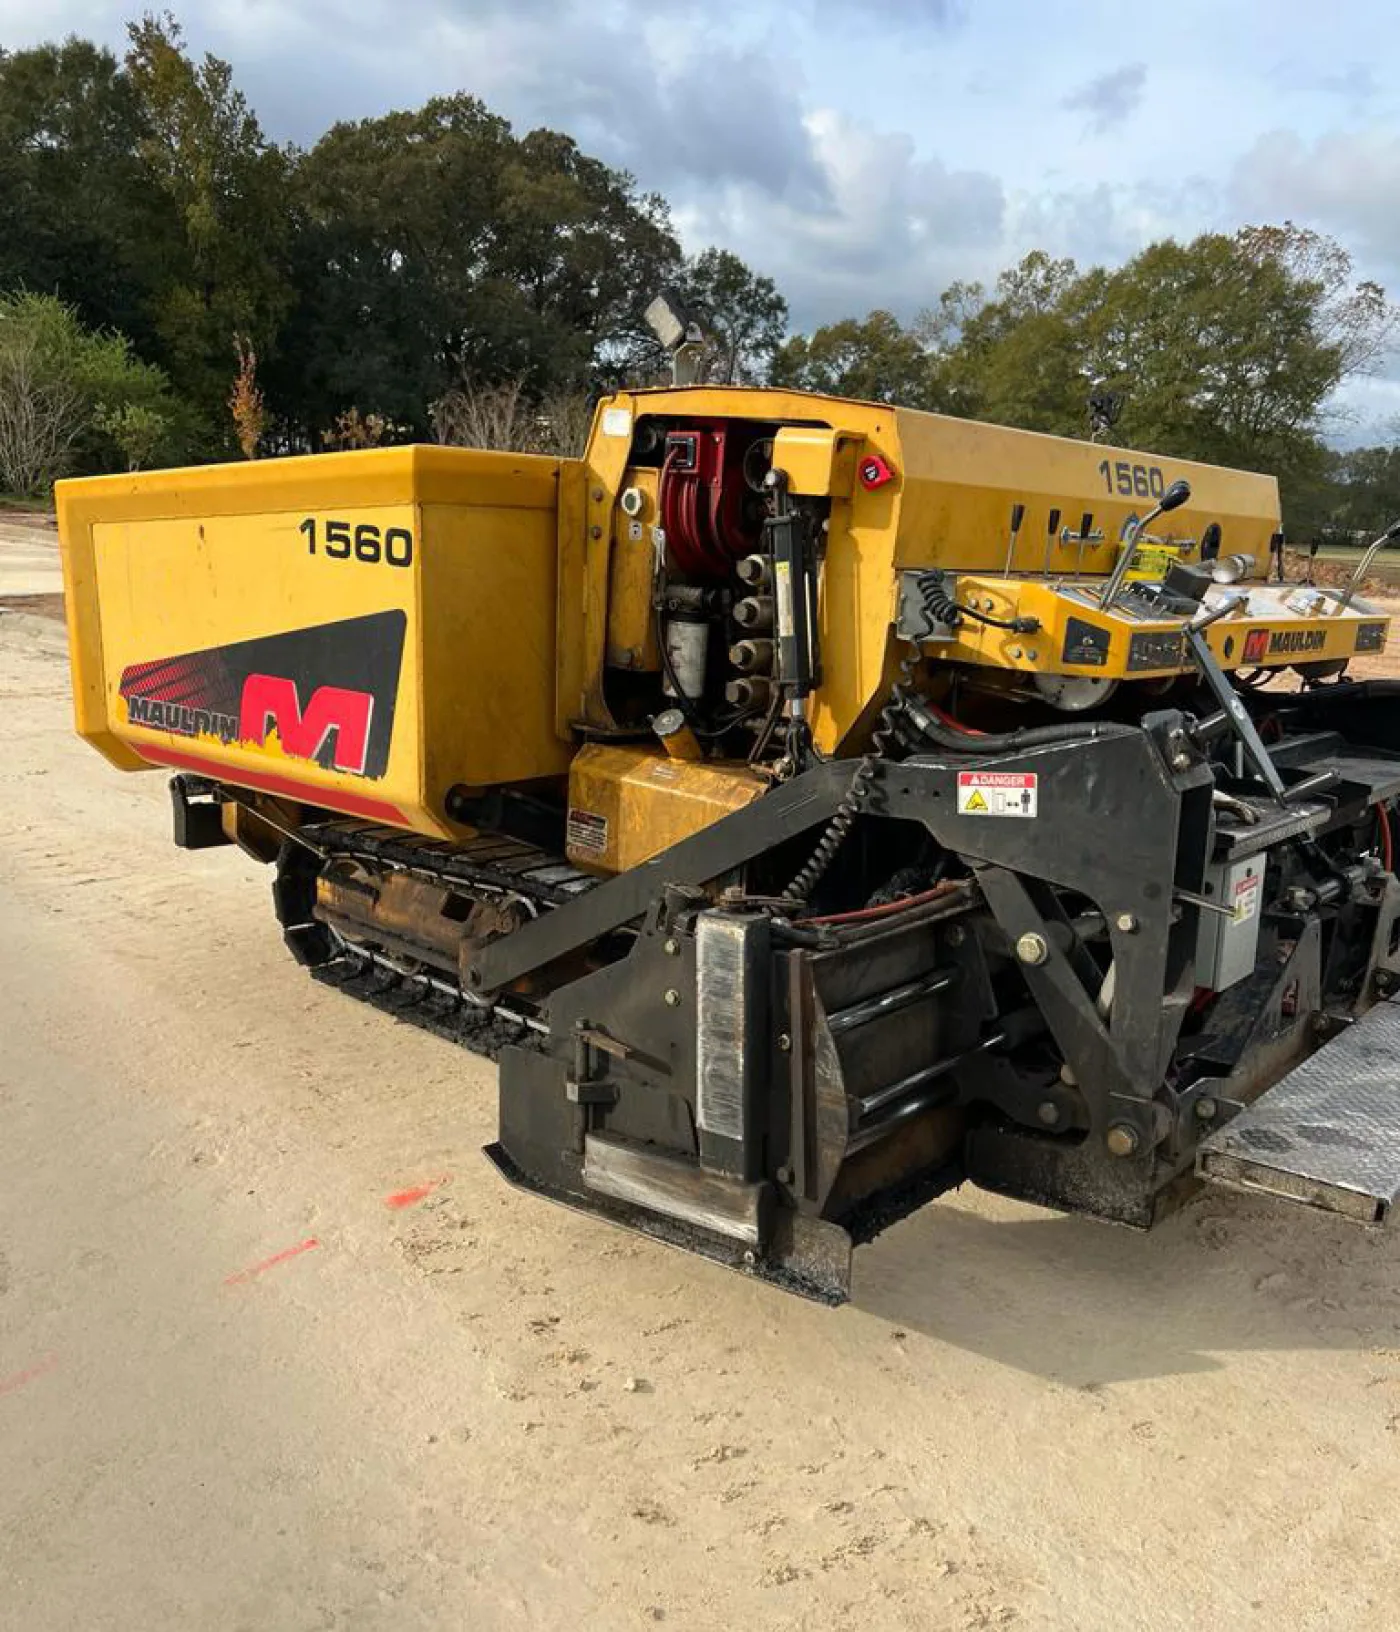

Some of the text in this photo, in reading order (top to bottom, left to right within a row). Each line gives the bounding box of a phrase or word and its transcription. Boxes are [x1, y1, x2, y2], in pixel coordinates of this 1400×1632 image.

[1099, 460, 1165, 498] 1560
[299, 517, 413, 568] 1560
[1269, 630, 1327, 653] MAULDIN
[128, 696, 239, 740] MAULDIN
[980, 774, 1025, 787] DANGER
